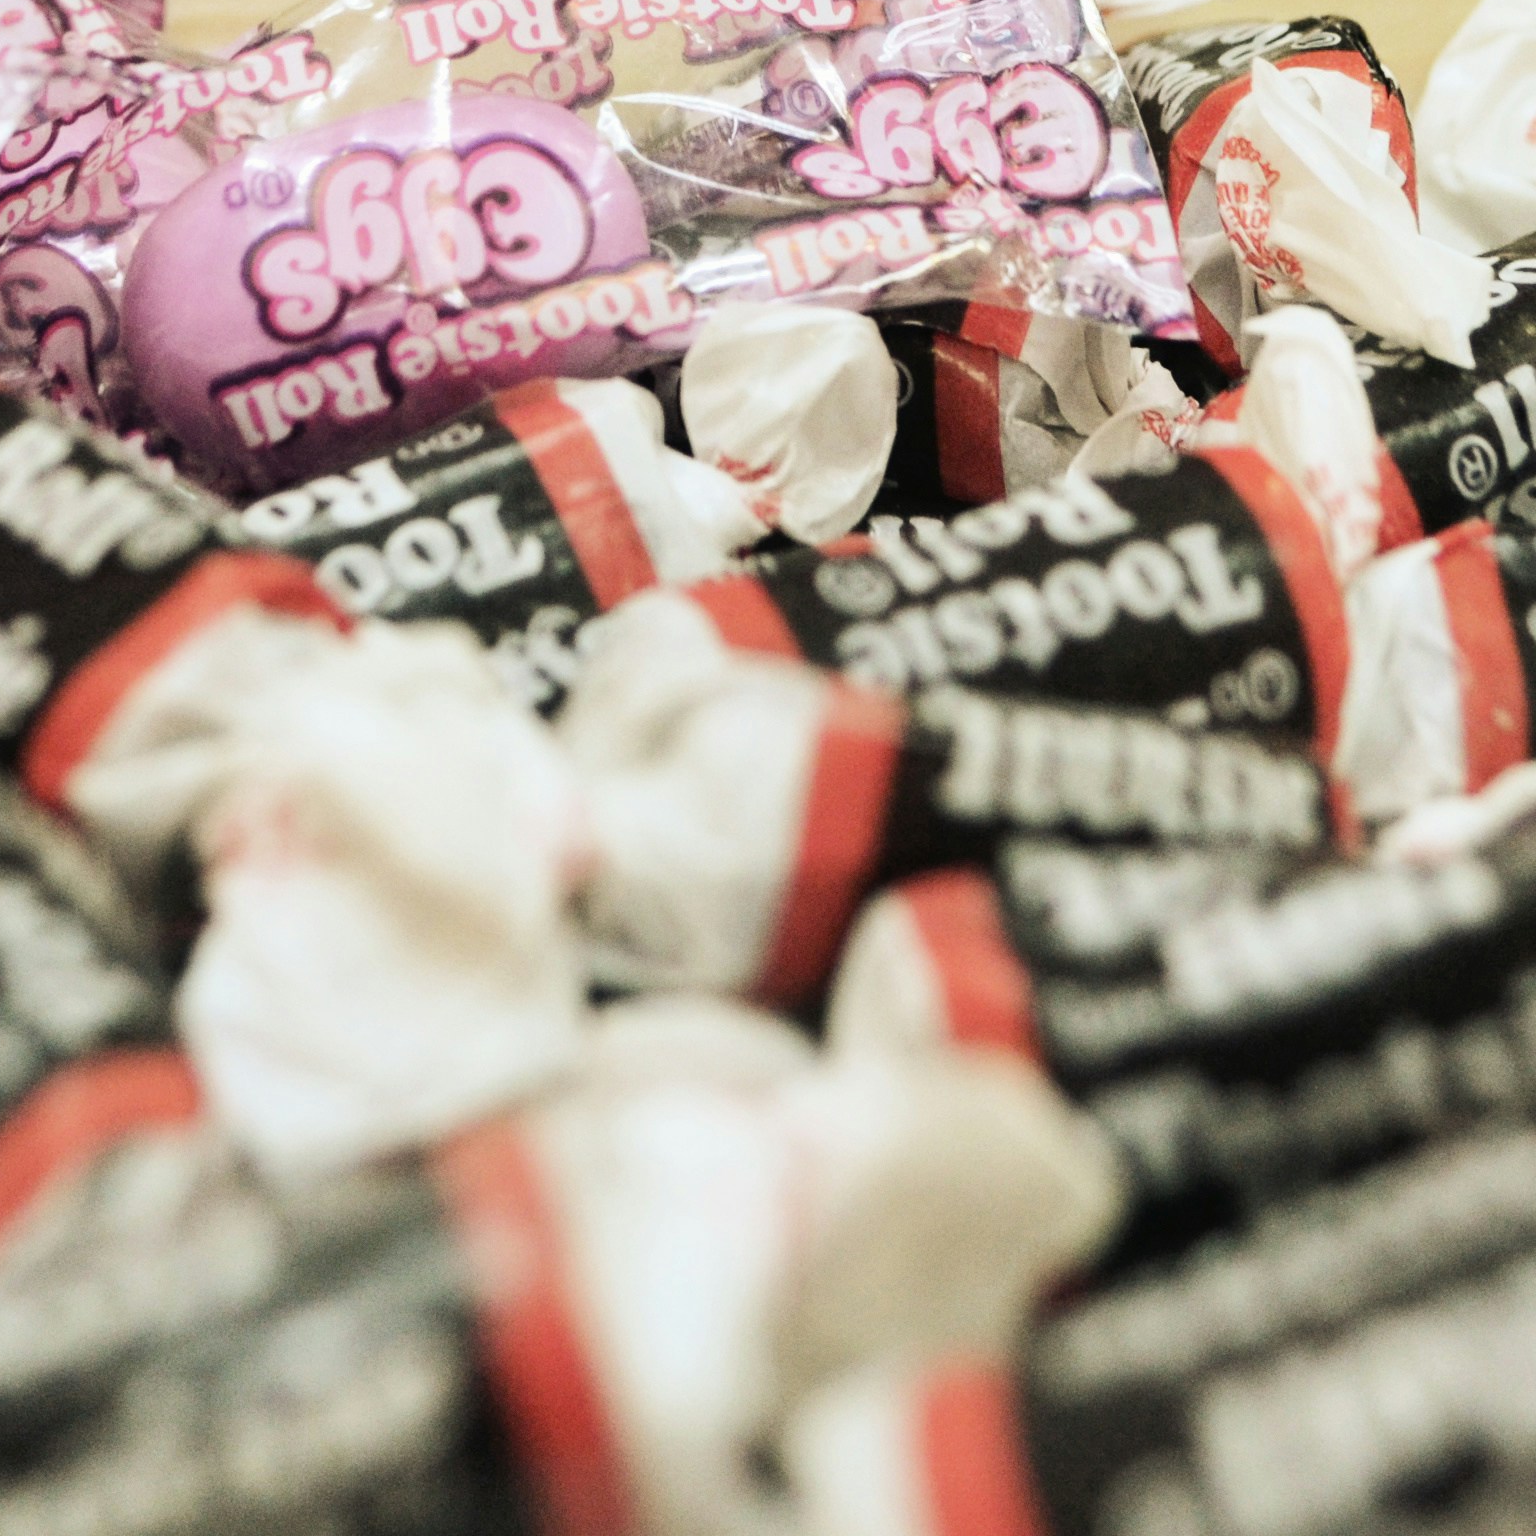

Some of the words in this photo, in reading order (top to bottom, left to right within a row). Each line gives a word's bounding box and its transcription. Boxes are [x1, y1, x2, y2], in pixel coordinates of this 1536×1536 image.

[790, 62, 1112, 202] Eggs
[241, 134, 596, 343] Eggs
[756, 201, 936, 296] Roll
[388, 266, 695, 381] Tootsie
[210, 329, 405, 452] Roll
[834, 522, 1264, 692] Tootsie
